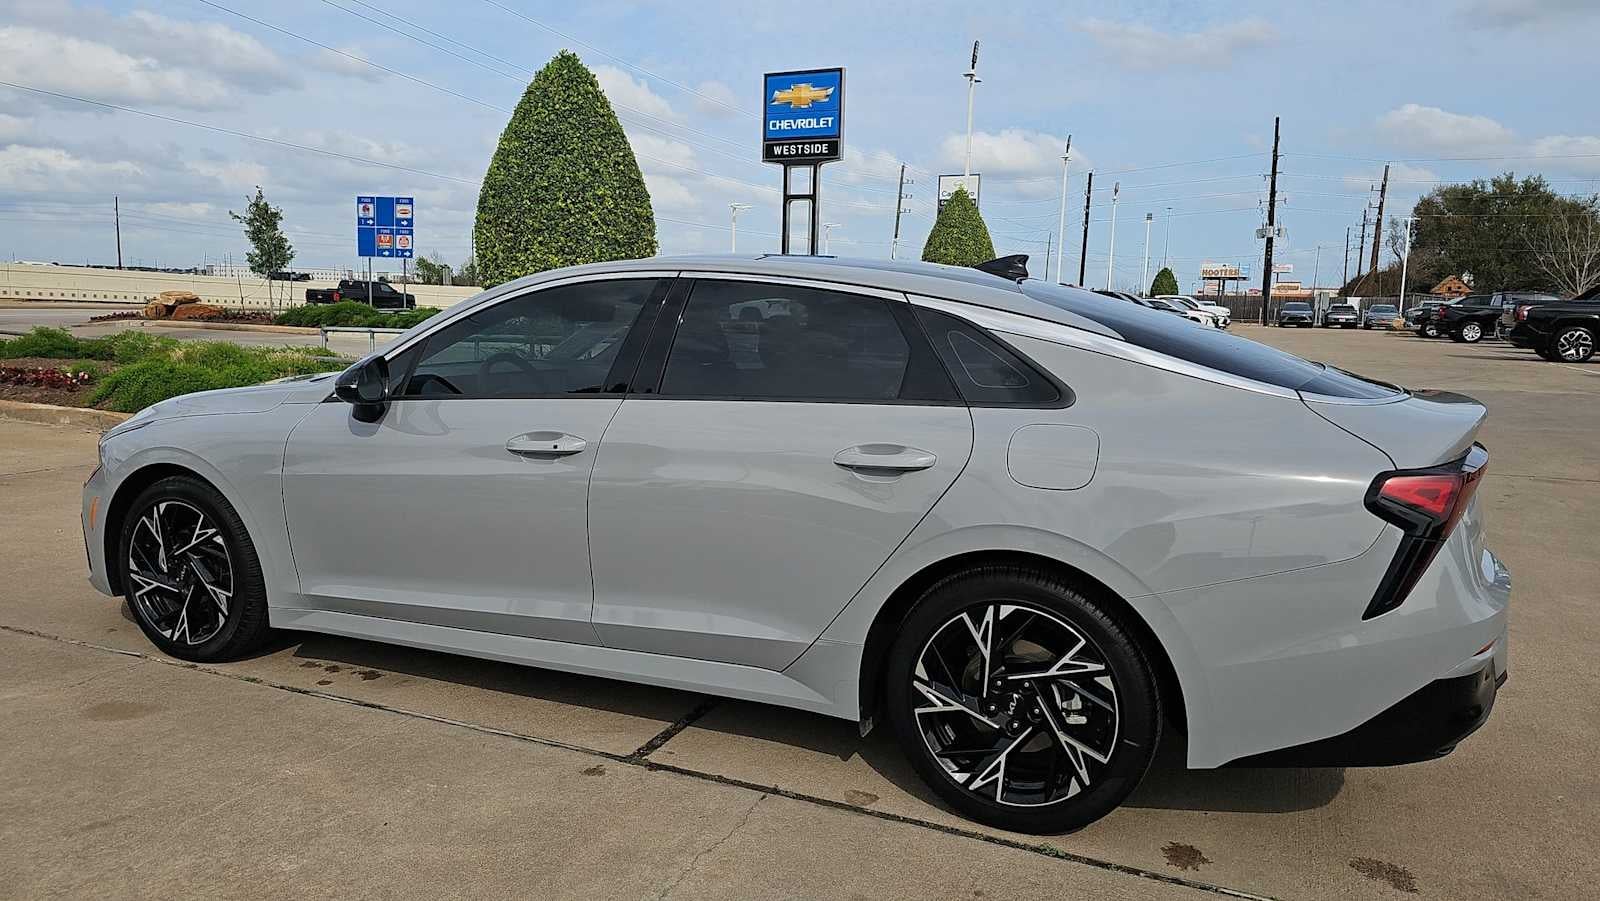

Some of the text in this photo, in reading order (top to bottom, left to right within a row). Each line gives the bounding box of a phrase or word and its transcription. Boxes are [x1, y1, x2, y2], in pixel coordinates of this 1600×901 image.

[769, 117, 834, 130] CHEVROLET
[773, 144, 829, 155] WESTSIDE
[1202, 268, 1239, 276] HOOTERS
